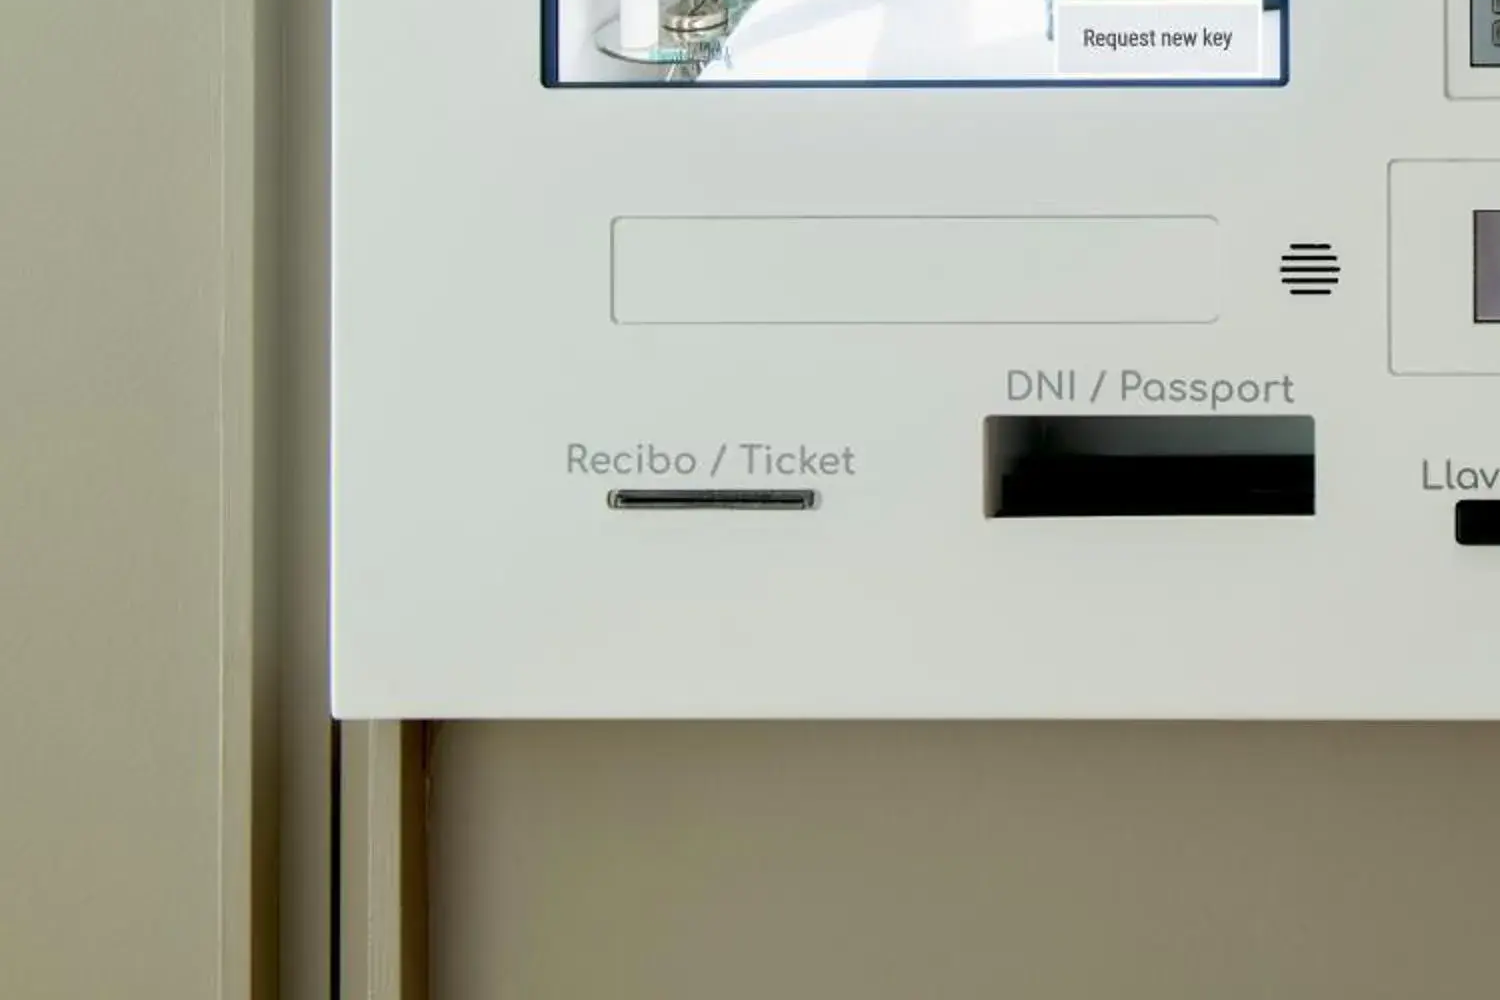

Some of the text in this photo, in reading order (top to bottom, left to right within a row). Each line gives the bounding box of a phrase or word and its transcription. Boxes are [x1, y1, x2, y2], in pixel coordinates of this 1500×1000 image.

[1083, 27, 1233, 52] Request new key
[1007, 369, 1295, 411] DNI / Passport
[567, 442, 856, 478] Recibo / Ticket
